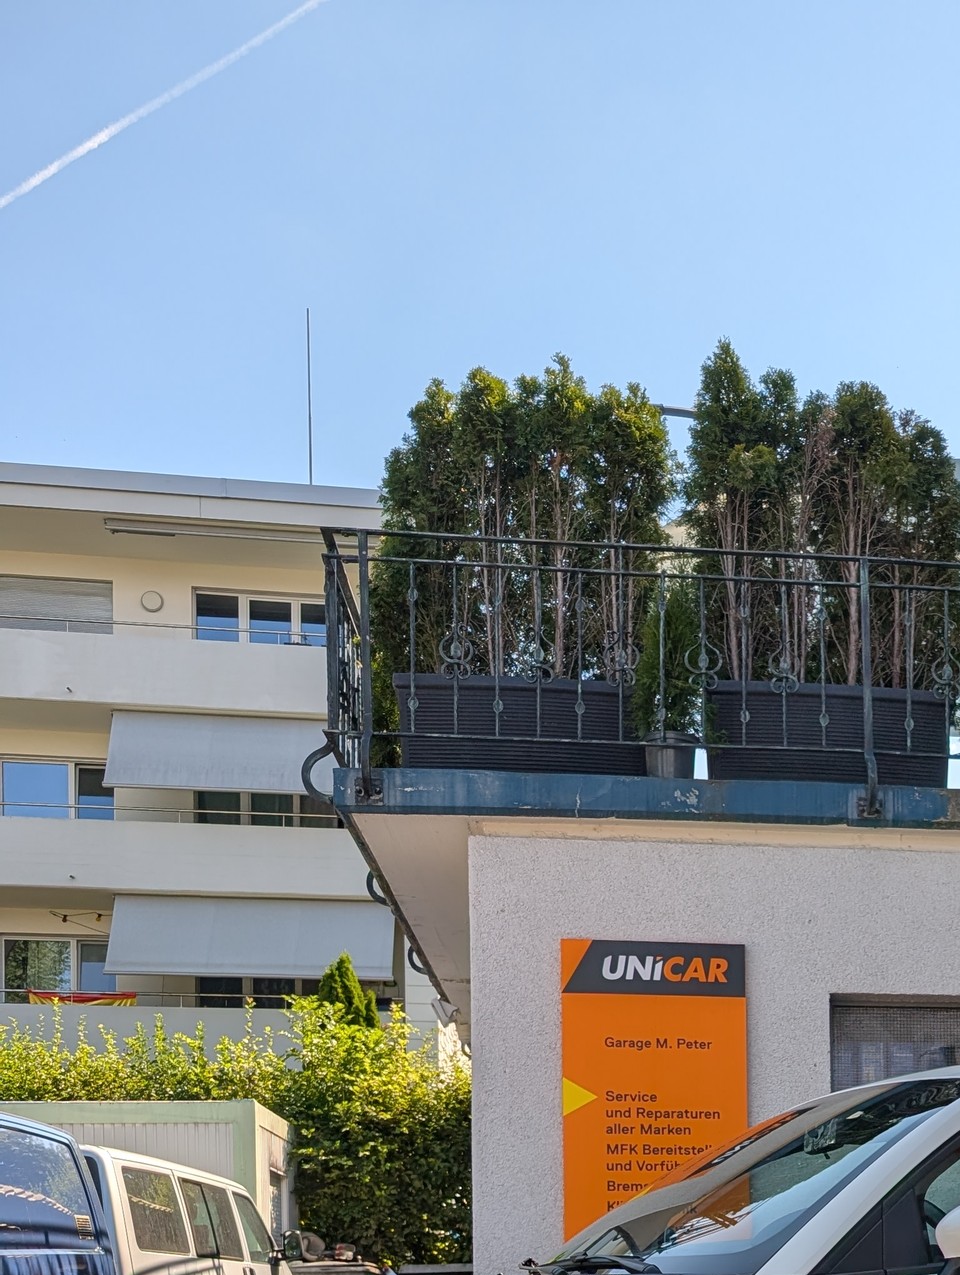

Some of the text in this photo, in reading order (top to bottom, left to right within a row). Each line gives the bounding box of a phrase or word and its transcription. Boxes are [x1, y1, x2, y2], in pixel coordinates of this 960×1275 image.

[604, 1036, 712, 1051] Garage M. Peter
[605, 1090, 658, 1102] Service
[606, 1107, 720, 1121] und Reparaturen
[606, 1123, 692, 1135] aller Marken
[606, 1143, 638, 1155] MFK
[606, 1160, 632, 1172] und
